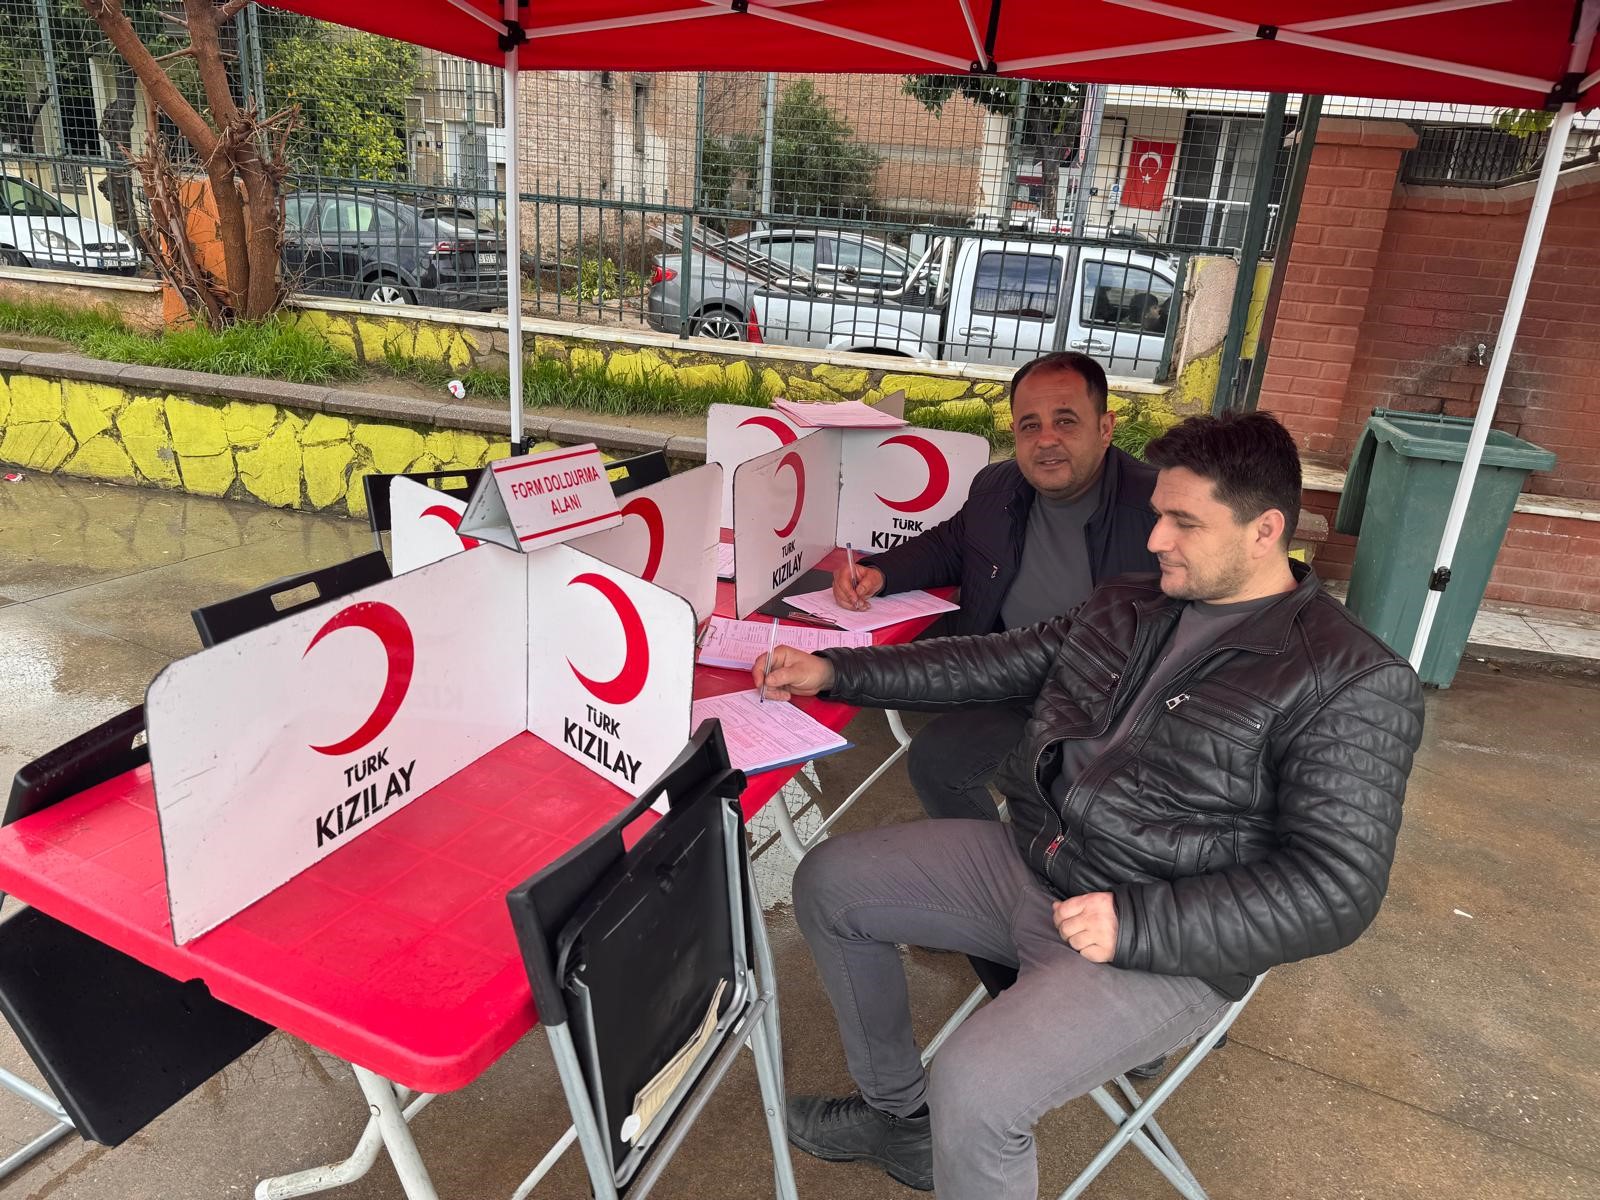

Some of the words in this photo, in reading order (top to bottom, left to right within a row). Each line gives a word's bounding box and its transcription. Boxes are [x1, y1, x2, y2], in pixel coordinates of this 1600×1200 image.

[511, 478, 544, 500] FORM
[543, 466, 600, 493] DOLDURMA
[550, 494, 582, 516] ALANI
[892, 517, 924, 532] TÜRK
[781, 539, 796, 558] TÜRK
[772, 551, 803, 589] KIZILAY
[585, 704, 621, 740] TÜRK
[343, 746, 390, 788] TÜRK
[564, 716, 642, 785] KIZILAY
[316, 759, 416, 848] KIZILAY
